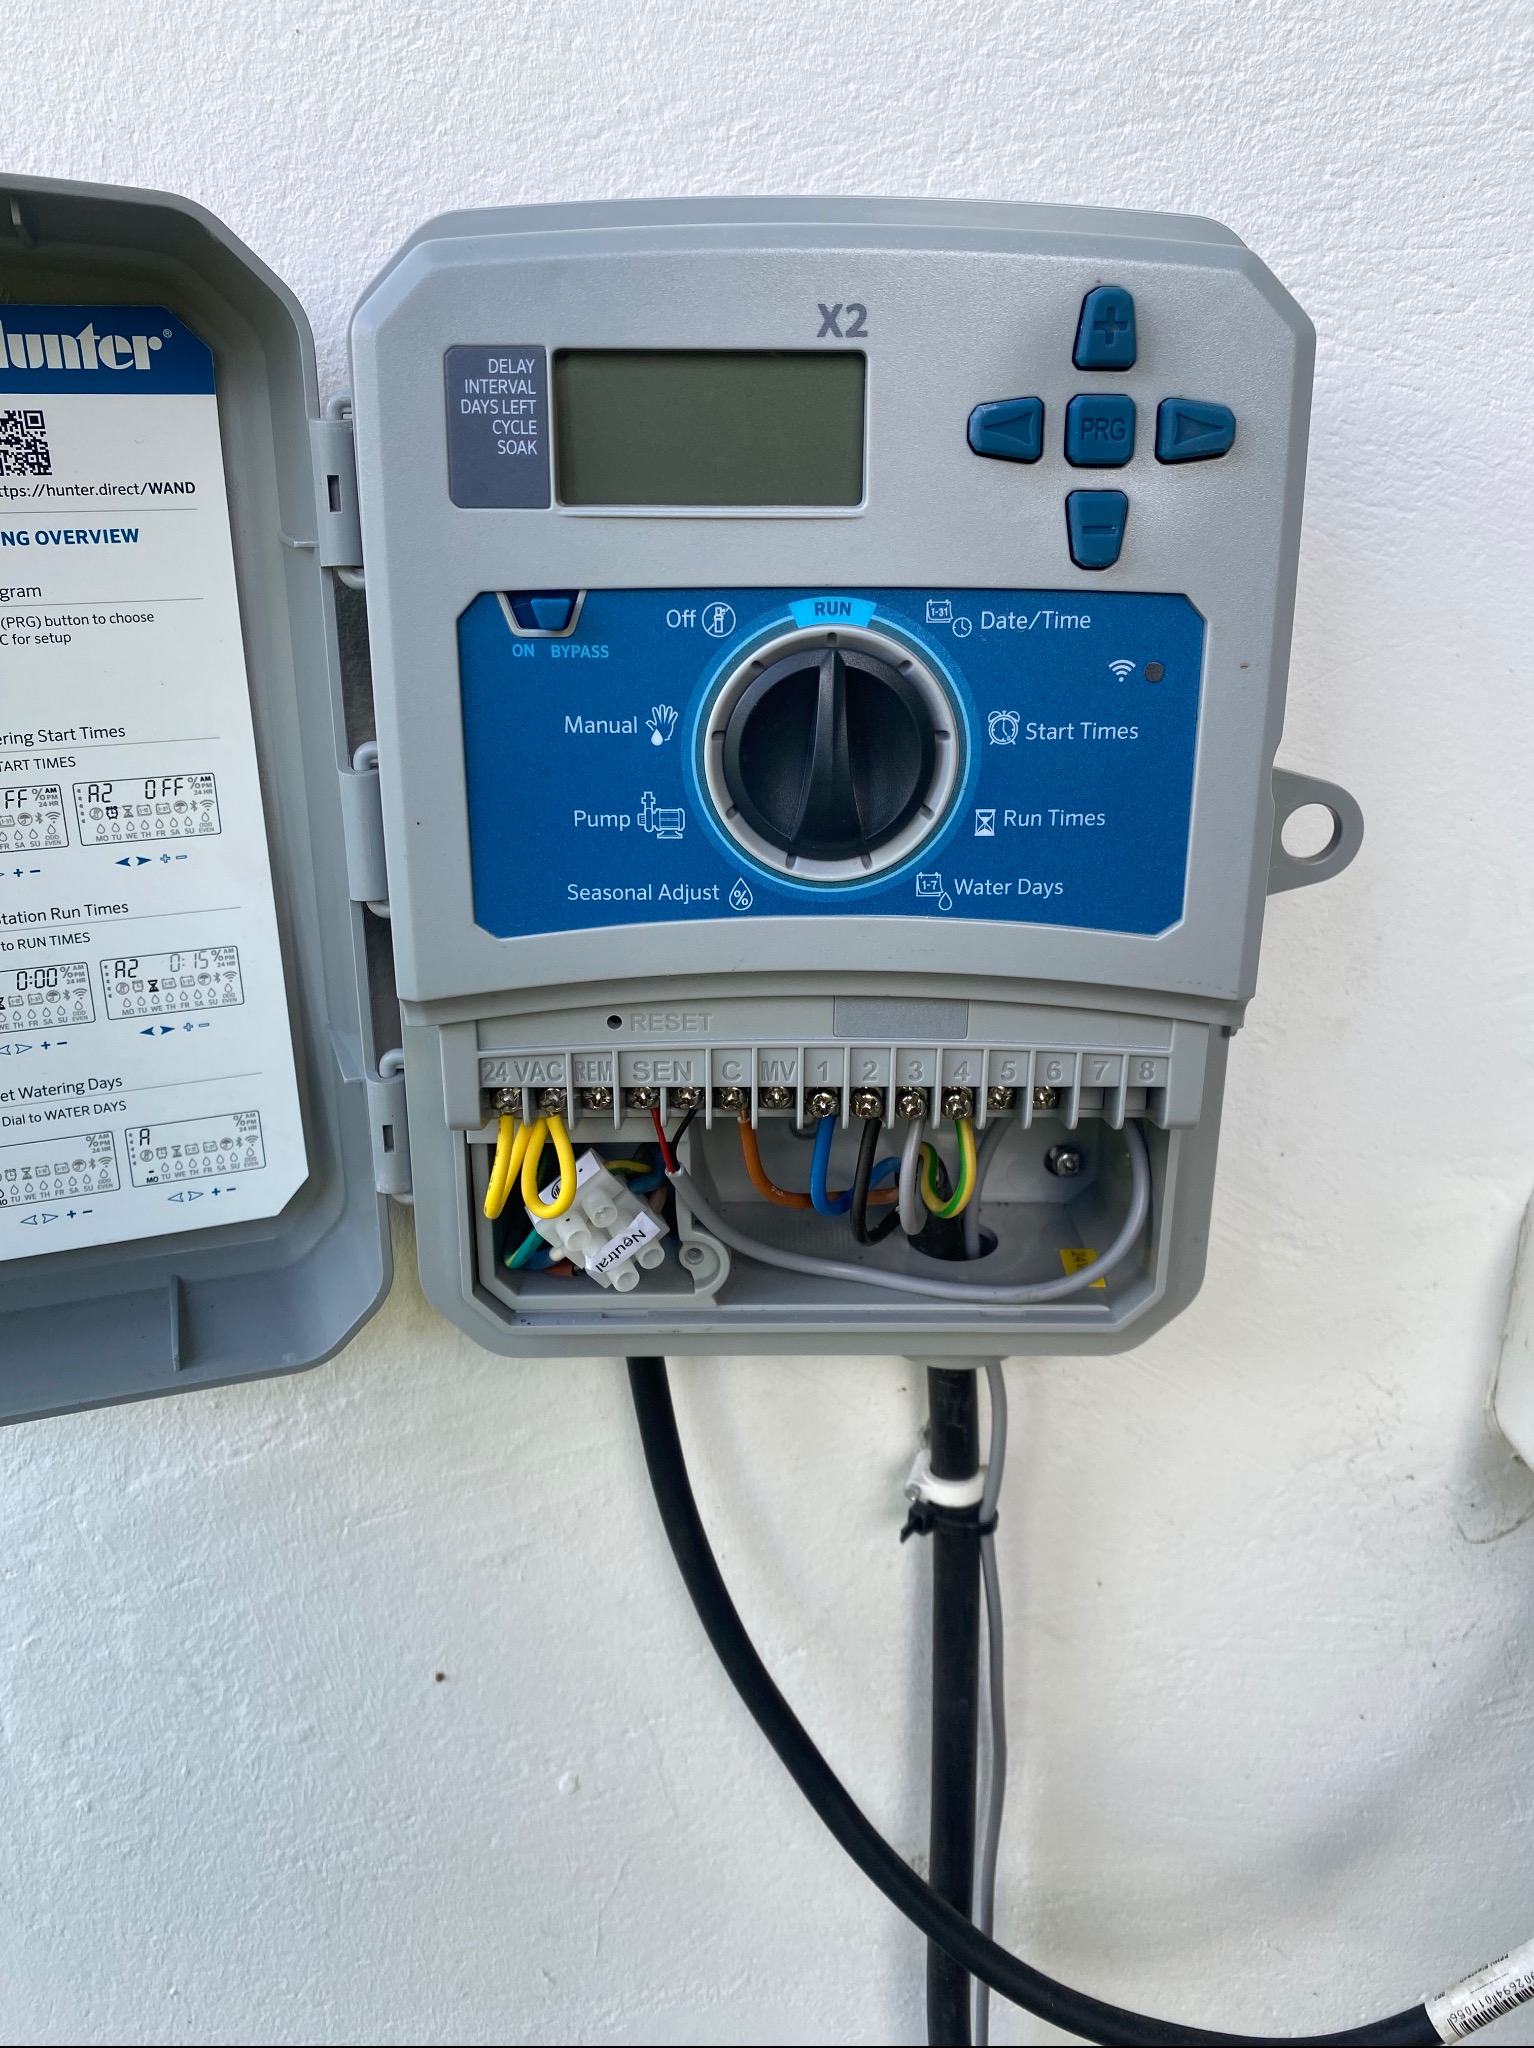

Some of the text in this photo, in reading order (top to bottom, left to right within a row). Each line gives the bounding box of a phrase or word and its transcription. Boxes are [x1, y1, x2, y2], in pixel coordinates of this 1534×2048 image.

[816, 303, 868, 339] X2
[488, 359, 535, 375] DELAY
[464, 379, 537, 395] INTERVAL
[460, 399, 536, 415] DAYS LEFT
[492, 420, 538, 436] CYCLE
[1080, 417, 1126, 441] PRG
[497, 440, 538, 456] SOAK
[1, 528, 139, 546] NG OVERVIEW
[0, 586, 42, 601] gram
[814, 602, 852, 616] RUN
[1, 612, 155, 630] (PRG) button to choose
[666, 609, 696, 628] Off
[980, 610, 1091, 630] Date/Time
[0, 632, 72, 646] C for setup
[511, 644, 609, 659] ON BYPASS
[564, 716, 638, 734] Manual
[1025, 722, 1139, 740] Start Times
[38, 728, 76, 743] Start
[79, 726, 126, 740] Times
[33, 756, 76, 770] TIMES
[5, 789, 27, 809] FF
[88, 778, 184, 803] A2 OFF
[574, 810, 631, 831] Pump
[1003, 810, 1106, 827] Run Times
[125, 832, 138, 840] WE
[567, 883, 720, 905] Seasonal Adjust
[954, 879, 1012, 896] Water
[1018, 878, 1064, 898] Days
[0, 903, 129, 925] tation Run Times
[0, 932, 91, 952] to RUN TIMES
[114, 959, 139, 978] A2
[17, 968, 58, 991] 0:00
[121, 1008, 135, 1016] MO
[166, 1003, 176, 1011] TH
[630, 1013, 713, 1032] RESET
[482, 1060, 1155, 1083] 24 VAC REM SEN C MV 1 2 3 4 5 6 7 8
[0, 1076, 123, 1102] et Watering Days
[2, 1100, 127, 1127] Dial to WATER DAYS
[140, 1128, 150, 1146] A
[146, 1176, 159, 1184] MO
[595, 1229, 647, 1273] Neutral
